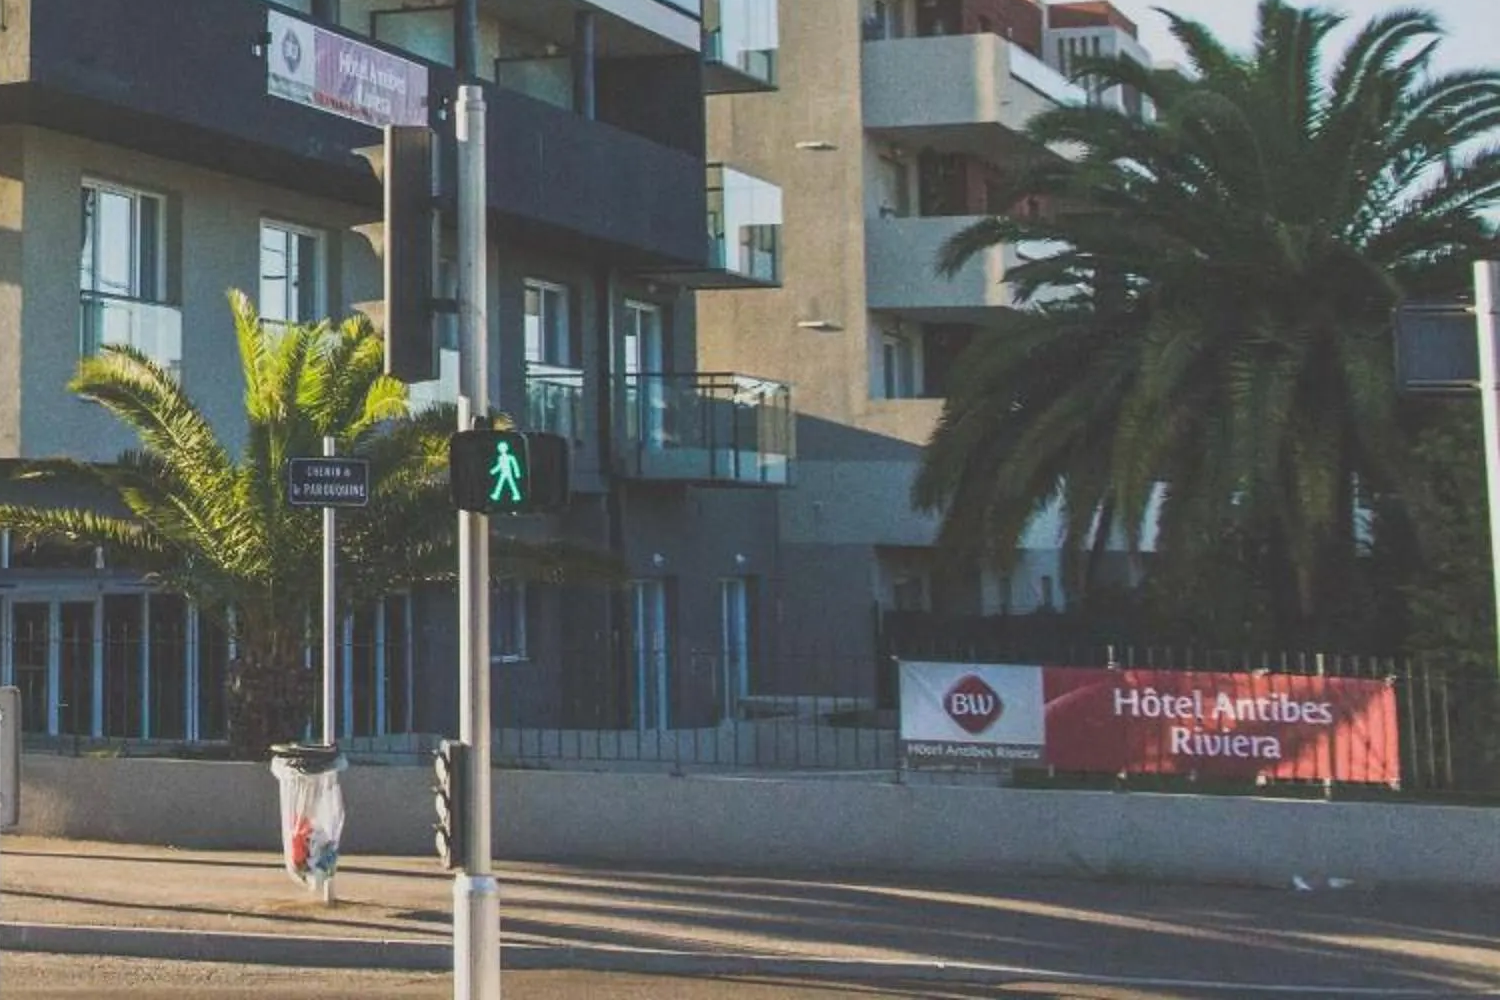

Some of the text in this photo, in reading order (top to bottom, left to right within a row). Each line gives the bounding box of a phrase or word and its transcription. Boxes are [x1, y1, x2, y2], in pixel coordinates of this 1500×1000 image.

[951, 693, 994, 716] BW
[1113, 687, 1333, 724] Hôtel Antibes
[1170, 725, 1281, 758] Riviera
